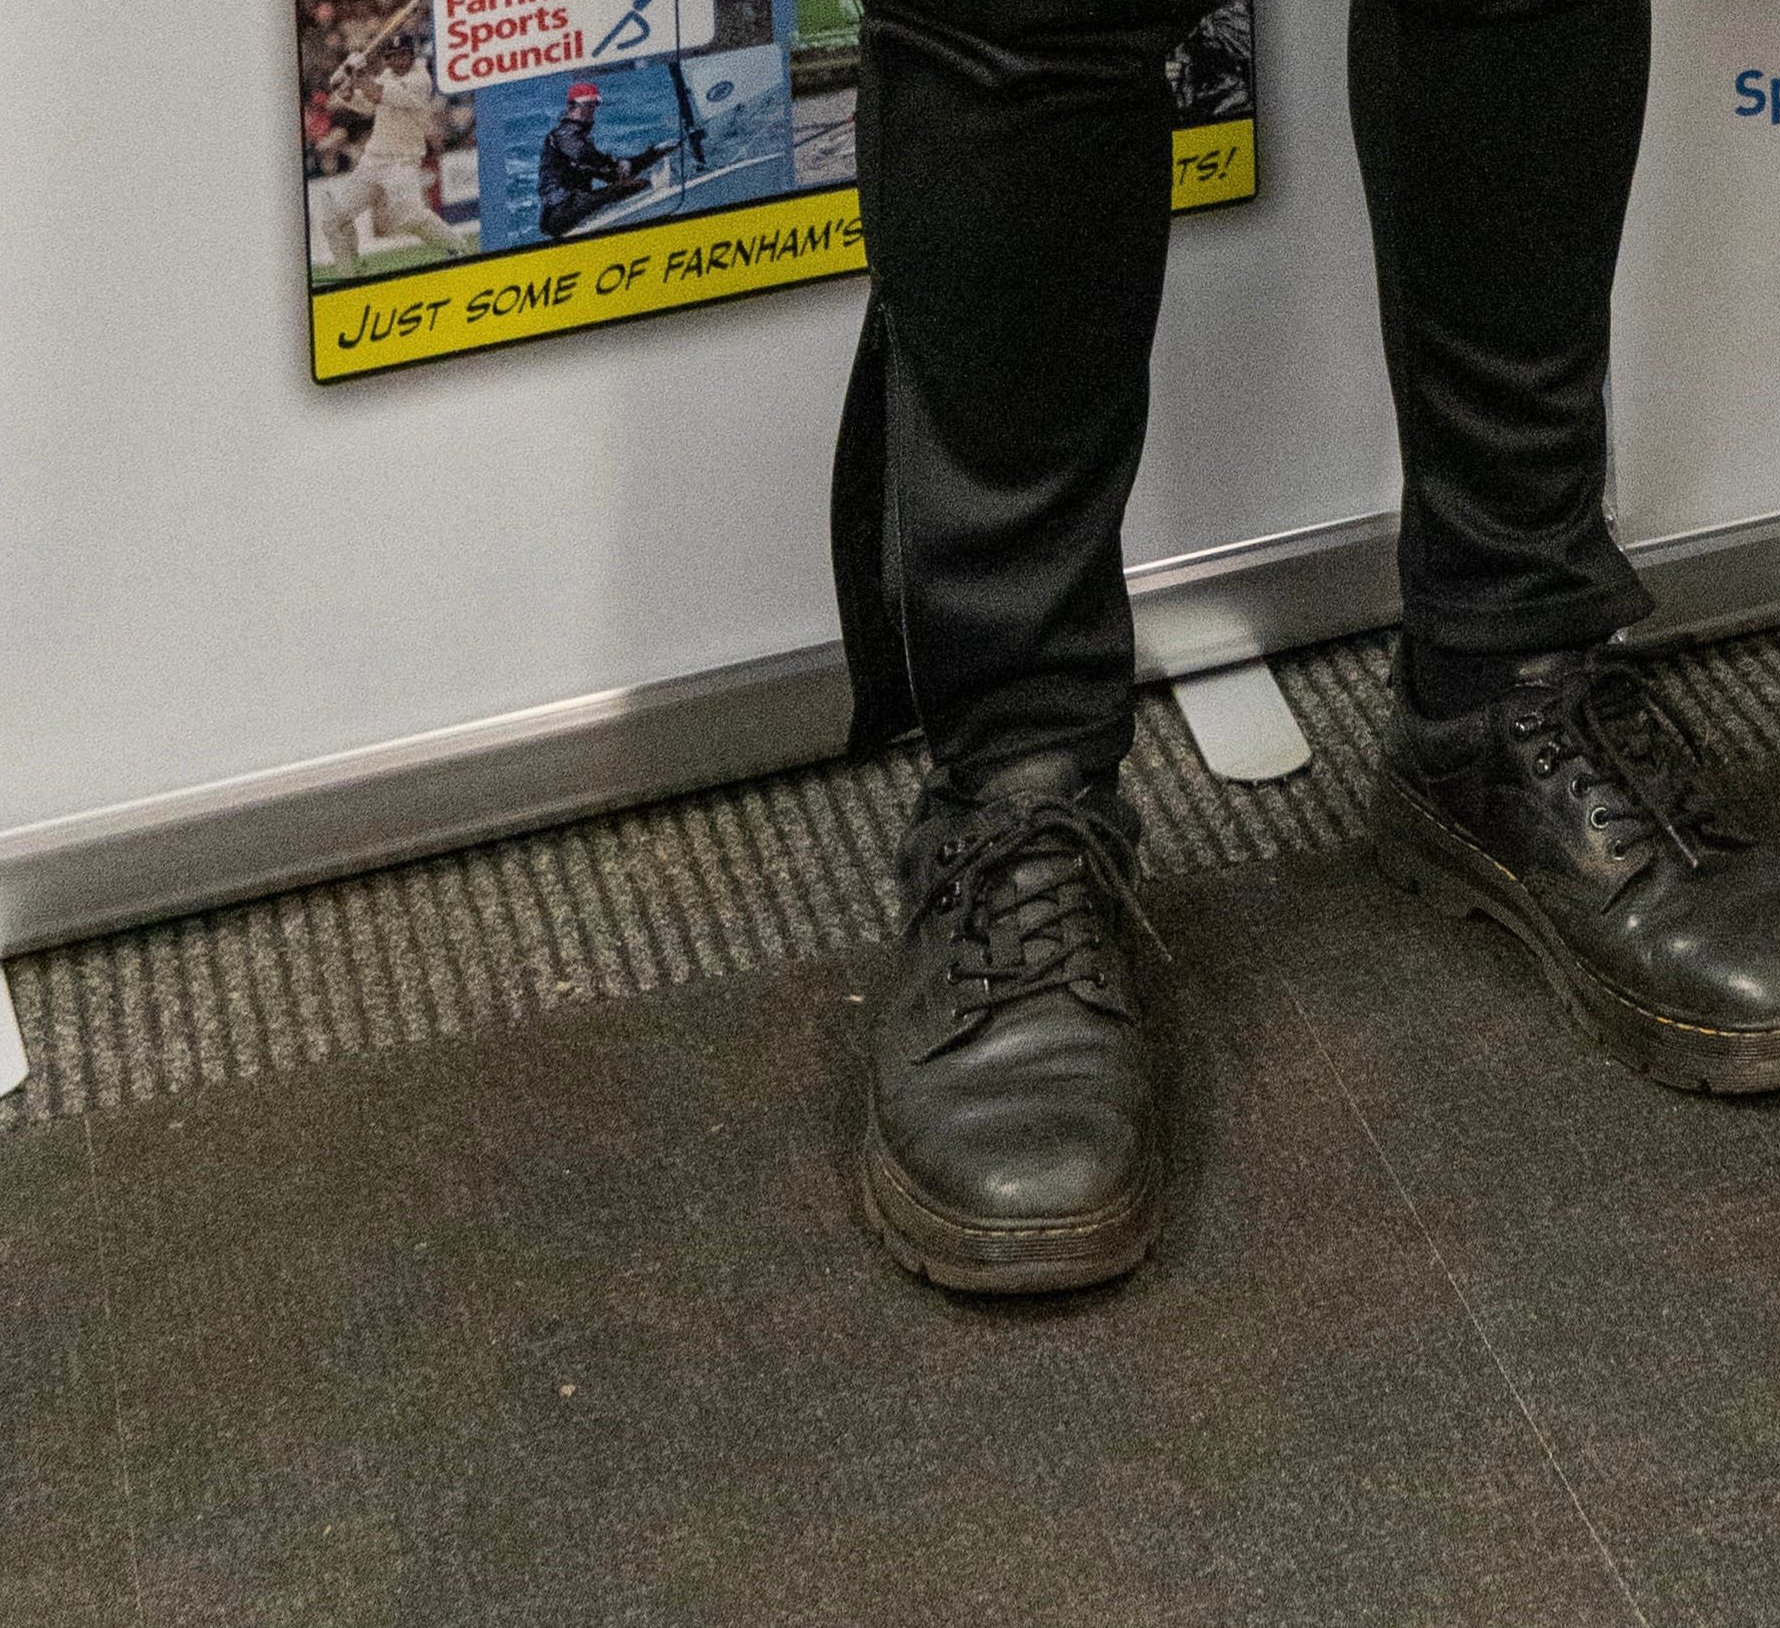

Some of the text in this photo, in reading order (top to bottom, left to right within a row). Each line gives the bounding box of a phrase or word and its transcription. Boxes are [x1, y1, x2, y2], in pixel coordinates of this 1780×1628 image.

[447, 7, 569, 52] Sports
[447, 32, 585, 84] Council
[338, 218, 864, 349] JUST SOME OF FARNHAM'S
